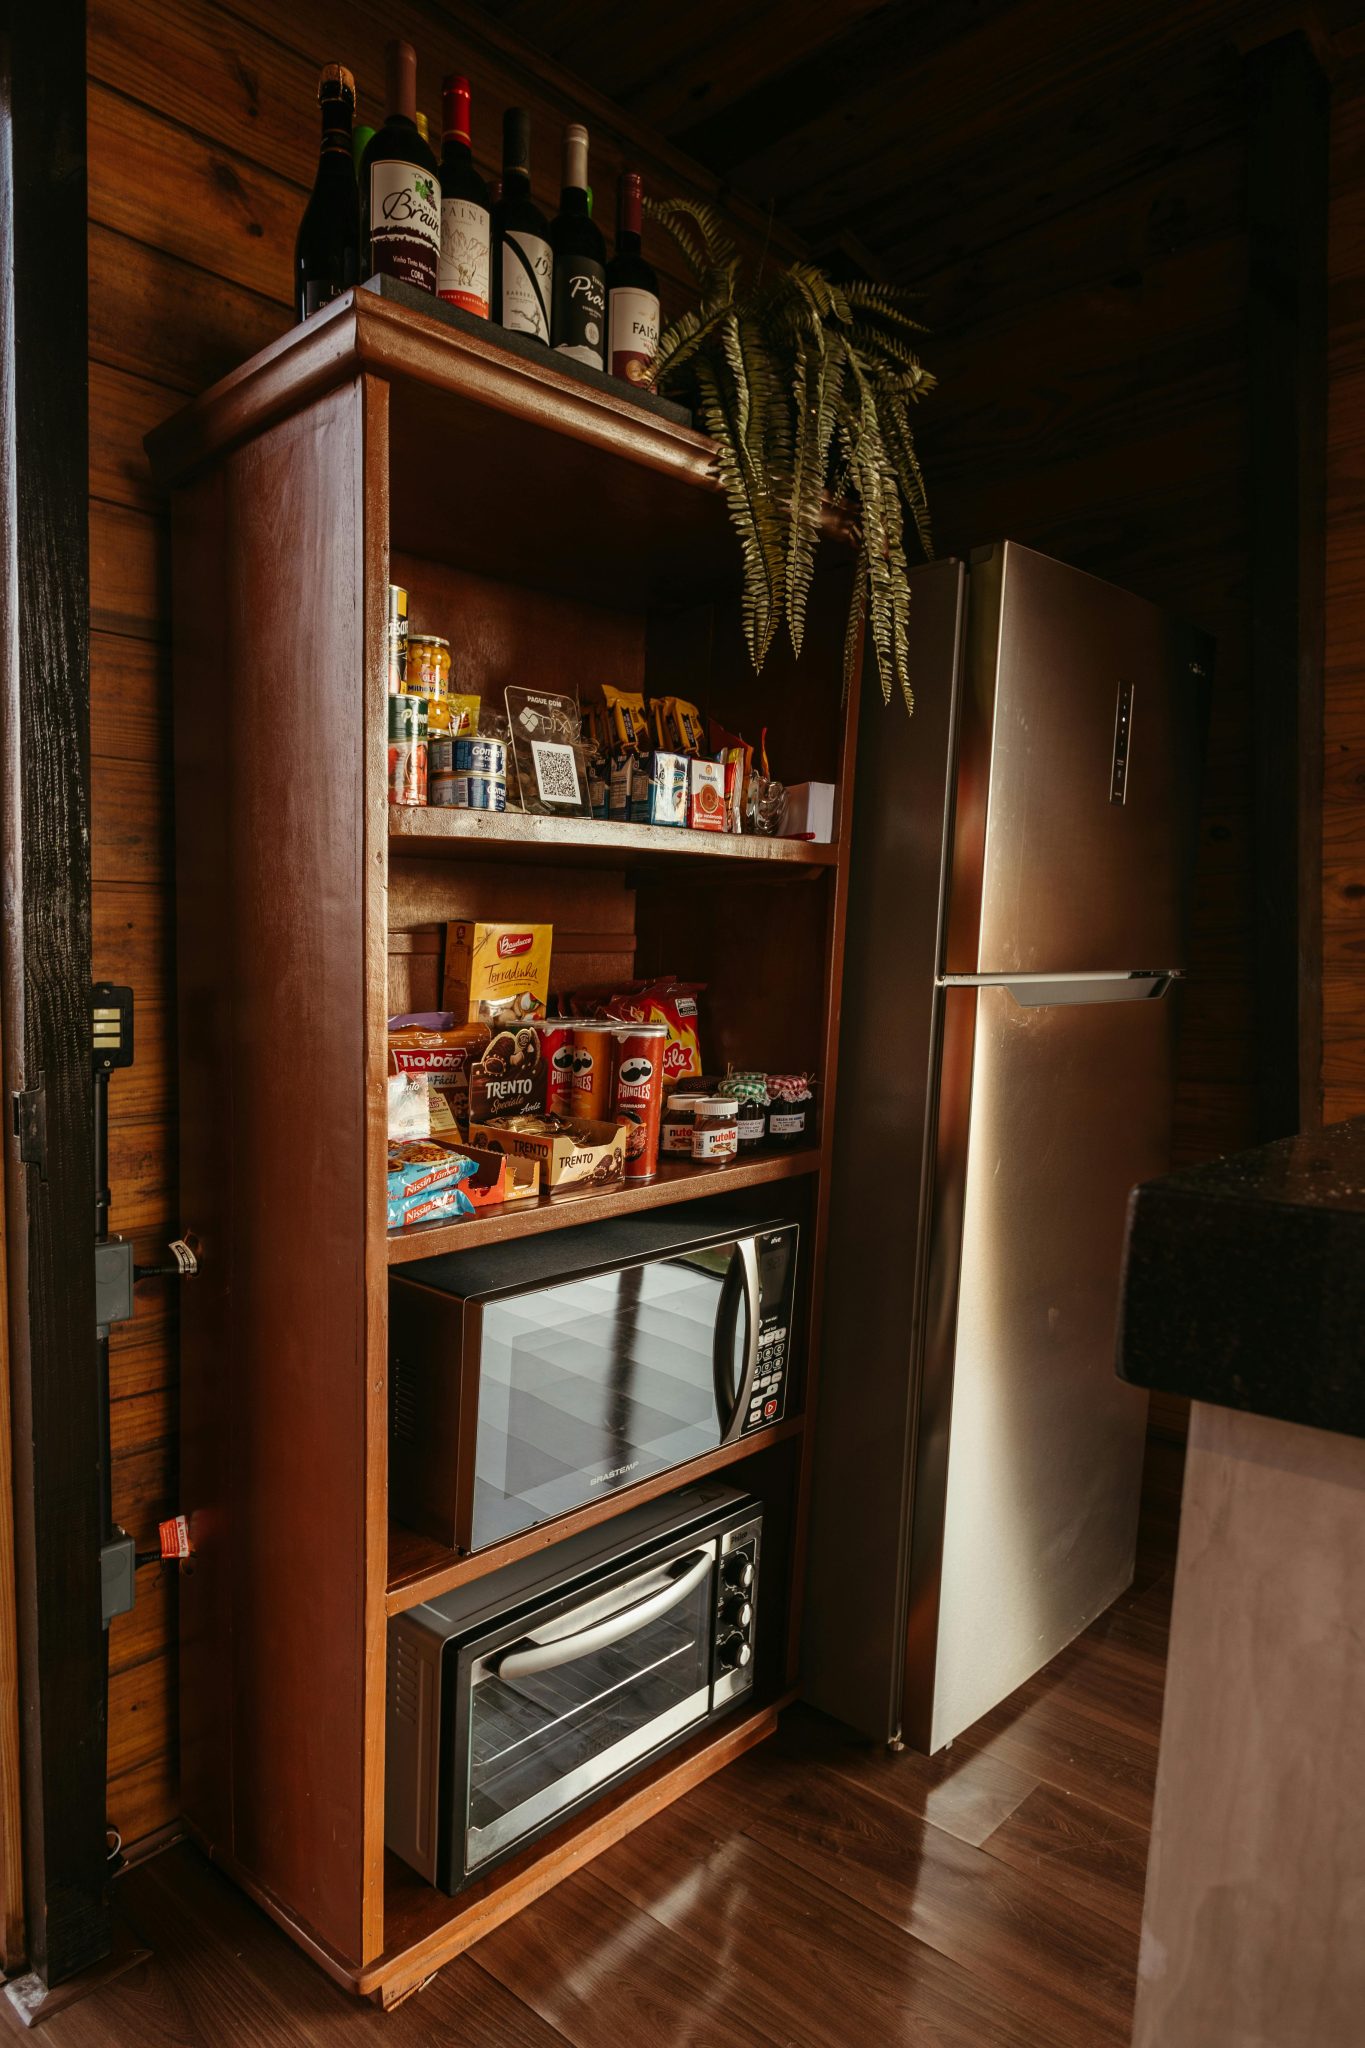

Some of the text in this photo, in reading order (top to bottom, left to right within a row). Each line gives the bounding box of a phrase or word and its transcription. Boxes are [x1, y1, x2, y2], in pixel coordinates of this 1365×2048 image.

[527, 695, 562, 708] PAGUE COM
[484, 961, 539, 985] Torradinha
[399, 1052, 462, 1068] Tio João
[485, 1078, 533, 1100] TRENTO
[617, 1083, 651, 1100] PRINGLES
[709, 1130, 737, 1143] nutella
[512, 1139, 549, 1158] TRENTO
[558, 1152, 594, 1169] TRENTO
[405, 1177, 431, 1197] Nissin
[405, 1203, 431, 1224] Nissin
[590, 1461, 640, 1487] BRASTEMP
